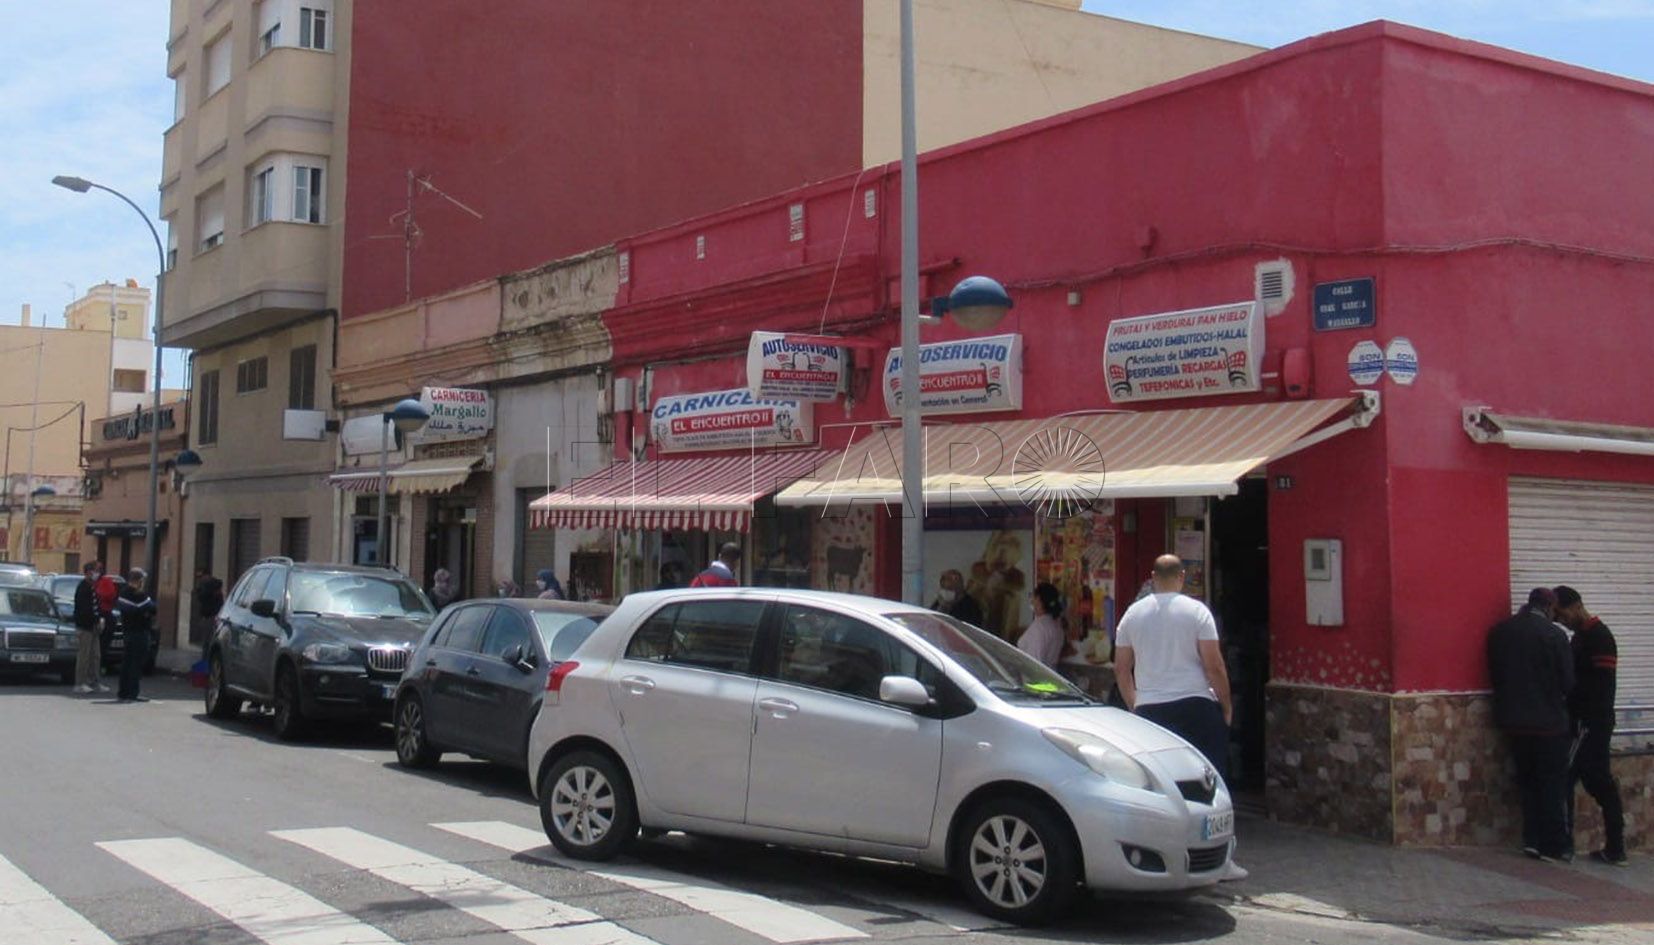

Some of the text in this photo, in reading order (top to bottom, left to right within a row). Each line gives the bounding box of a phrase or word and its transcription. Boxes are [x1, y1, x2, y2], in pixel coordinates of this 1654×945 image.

[1144, 321, 1150, 332] Y
[1151, 317, 1196, 331] VERDURAS
[1197, 314, 1217, 327] PAN
[1218, 311, 1248, 325] HIELO
[1108, 339, 1163, 353] CONGELADOS
[1169, 350, 1177, 361] de
[1178, 346, 1219, 361] LIMPIEZA
[889, 343, 1008, 373] AOSERVICIO
[1181, 359, 1227, 374] RECARGAS
[431, 389, 486, 403] CARNICERIA
[431, 403, 487, 419] Margallo
[674, 420, 686, 431] EL
[690, 413, 760, 430] ENCUENTRO
